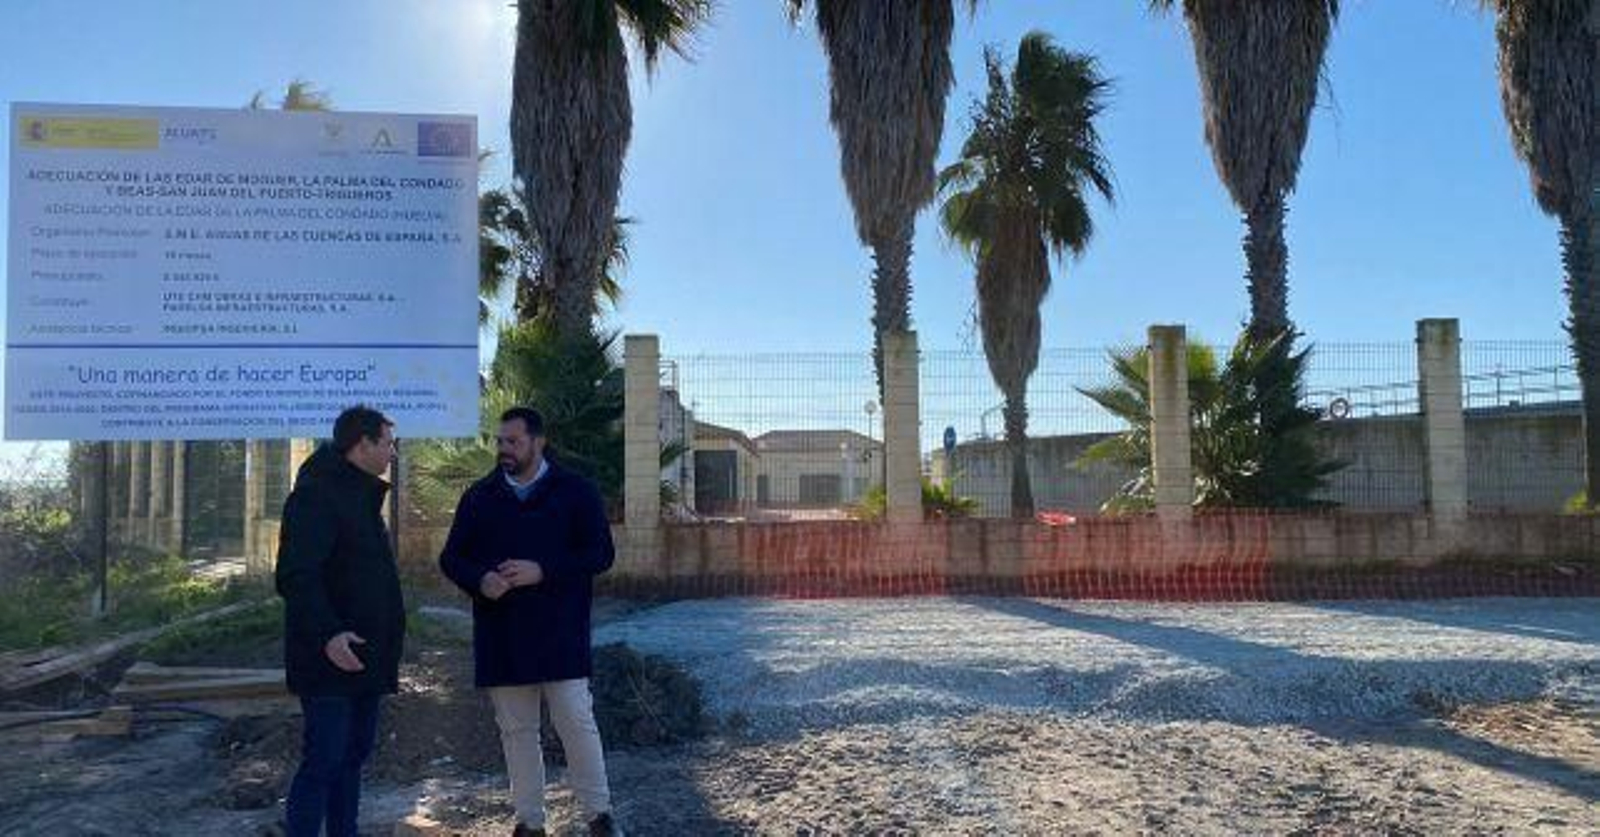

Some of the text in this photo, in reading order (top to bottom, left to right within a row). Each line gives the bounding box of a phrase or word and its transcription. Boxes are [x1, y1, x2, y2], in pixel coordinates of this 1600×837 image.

[26, 168, 119, 182] ADECUACIÓN
[123, 171, 140, 182] DE
[145, 172, 172, 184] LAS
[176, 172, 211, 184] EDAR
[216, 173, 235, 185] DE
[303, 175, 319, 187] LA
[323, 175, 366, 188] PALMA
[371, 176, 395, 188] DEL
[399, 177, 464, 190] CONDADO
[106, 186, 113, 195] Y
[191, 187, 226, 199] JUAN
[231, 188, 256, 199] DEL
[303, 231, 361, 243] CUENCAS
[365, 233, 381, 243] DE
[123, 367, 199, 384] manera
[205, 366, 230, 382] de
[237, 364, 294, 382] hacer
[300, 364, 376, 387] Europa"
